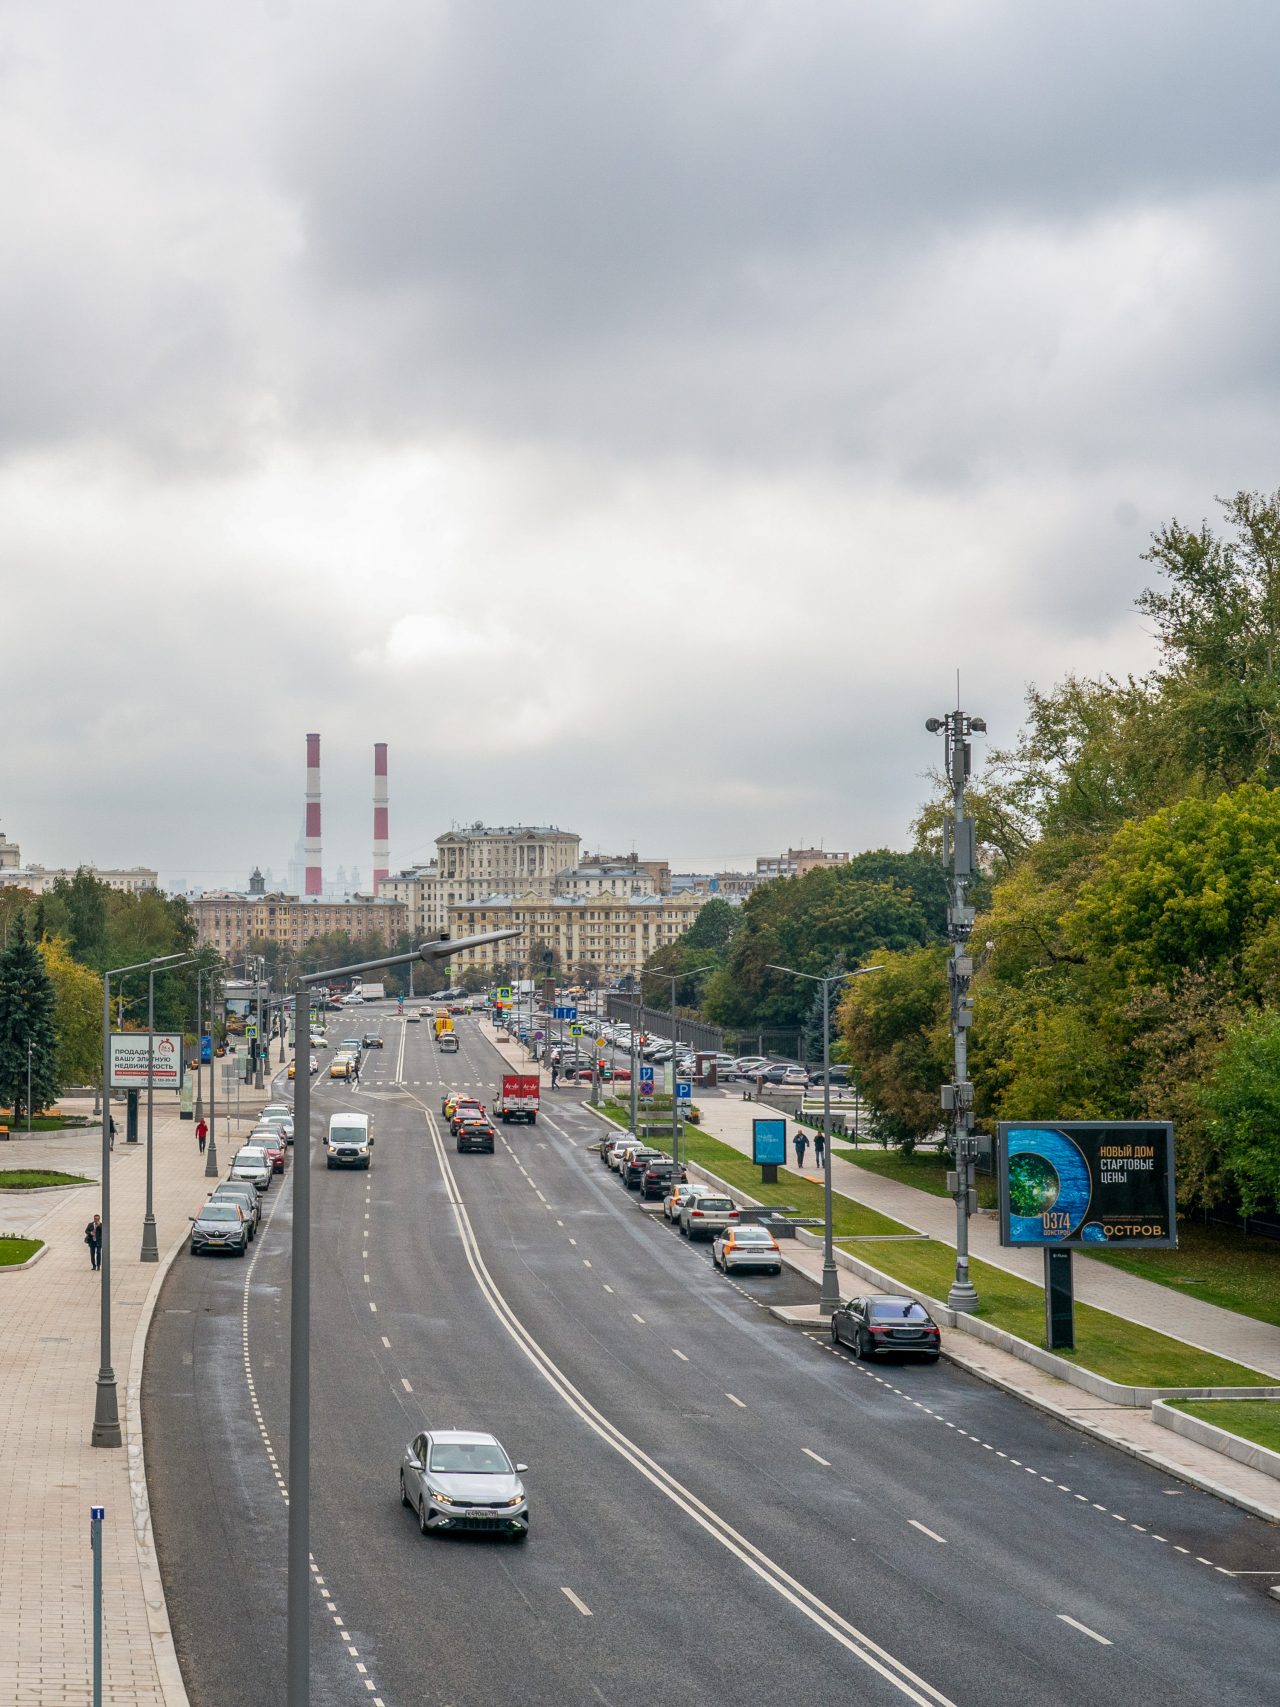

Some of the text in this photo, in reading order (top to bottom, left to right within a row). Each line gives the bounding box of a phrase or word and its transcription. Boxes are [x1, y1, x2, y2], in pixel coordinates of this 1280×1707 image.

[1100, 1144, 1154, 1158] НОВЫЙ ДОМ
[1100, 1158, 1155, 1170] СТАРТОВЫЕ
[1100, 1171, 1127, 1184] ЦЕНЫ
[1043, 1212, 1071, 1229] 0374
[1103, 1224, 1166, 1236] ОСТРОВ.
